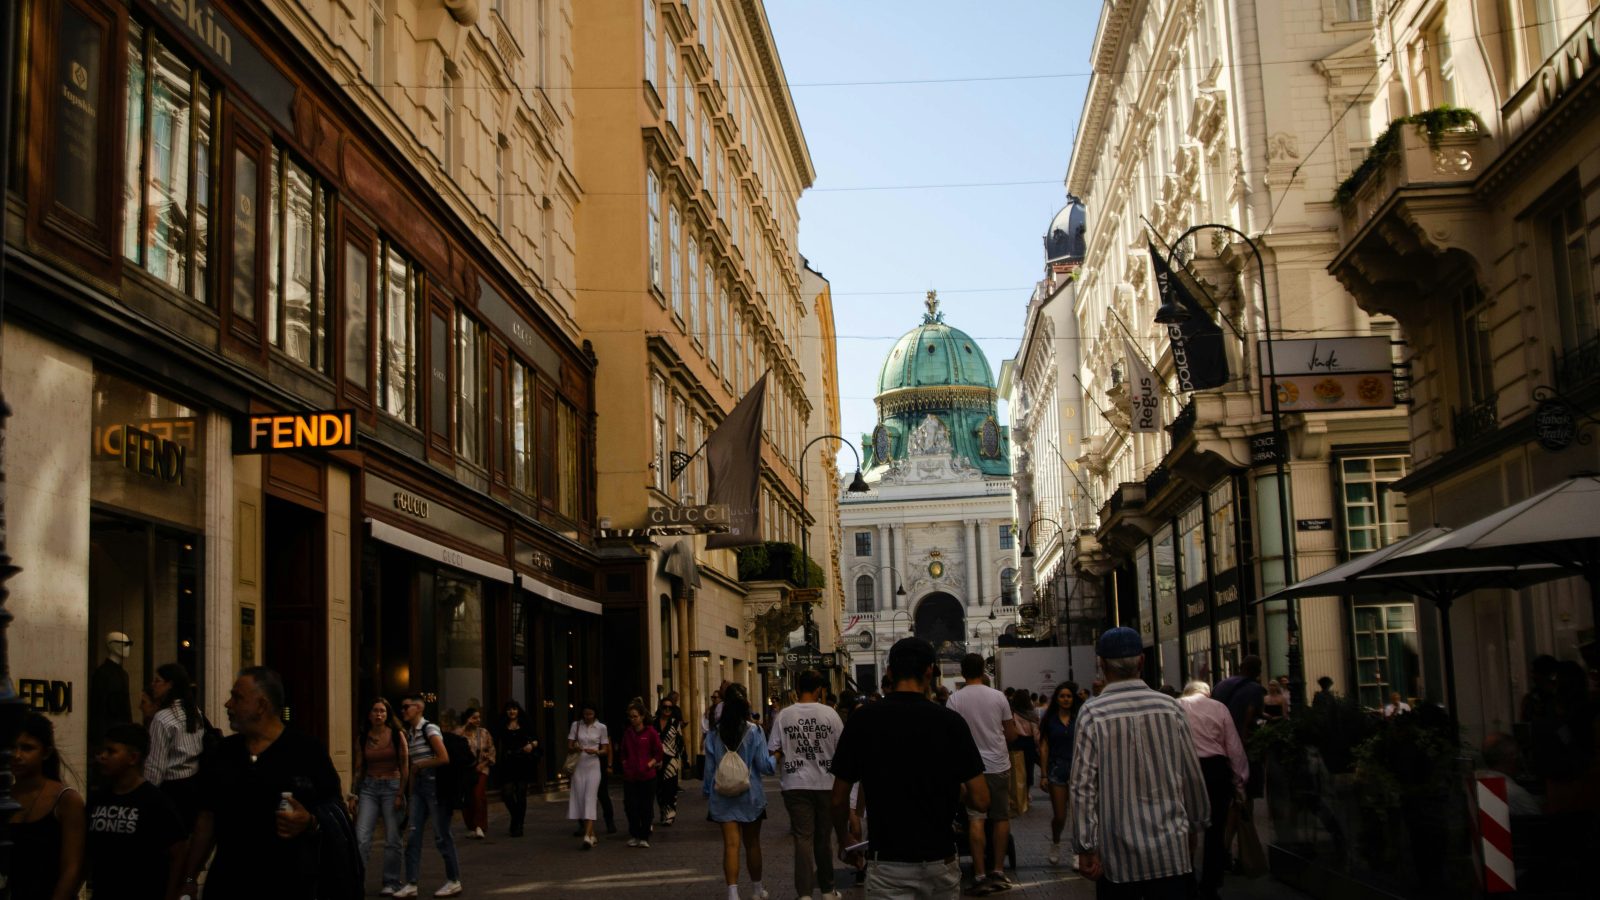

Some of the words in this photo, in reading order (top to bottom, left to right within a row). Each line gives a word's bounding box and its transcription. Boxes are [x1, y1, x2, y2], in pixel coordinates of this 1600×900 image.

[150, 0, 232, 66] skin
[1175, 348, 1194, 391] DOLCE
[1140, 377, 1159, 429] Regus
[250, 412, 351, 450] FENDI
[122, 424, 186, 487] FENDI
[400, 491, 430, 518] GUCCI
[651, 508, 726, 523] GUCCI
[20, 679, 72, 714] FENDI
[89, 818, 137, 835] JONES
